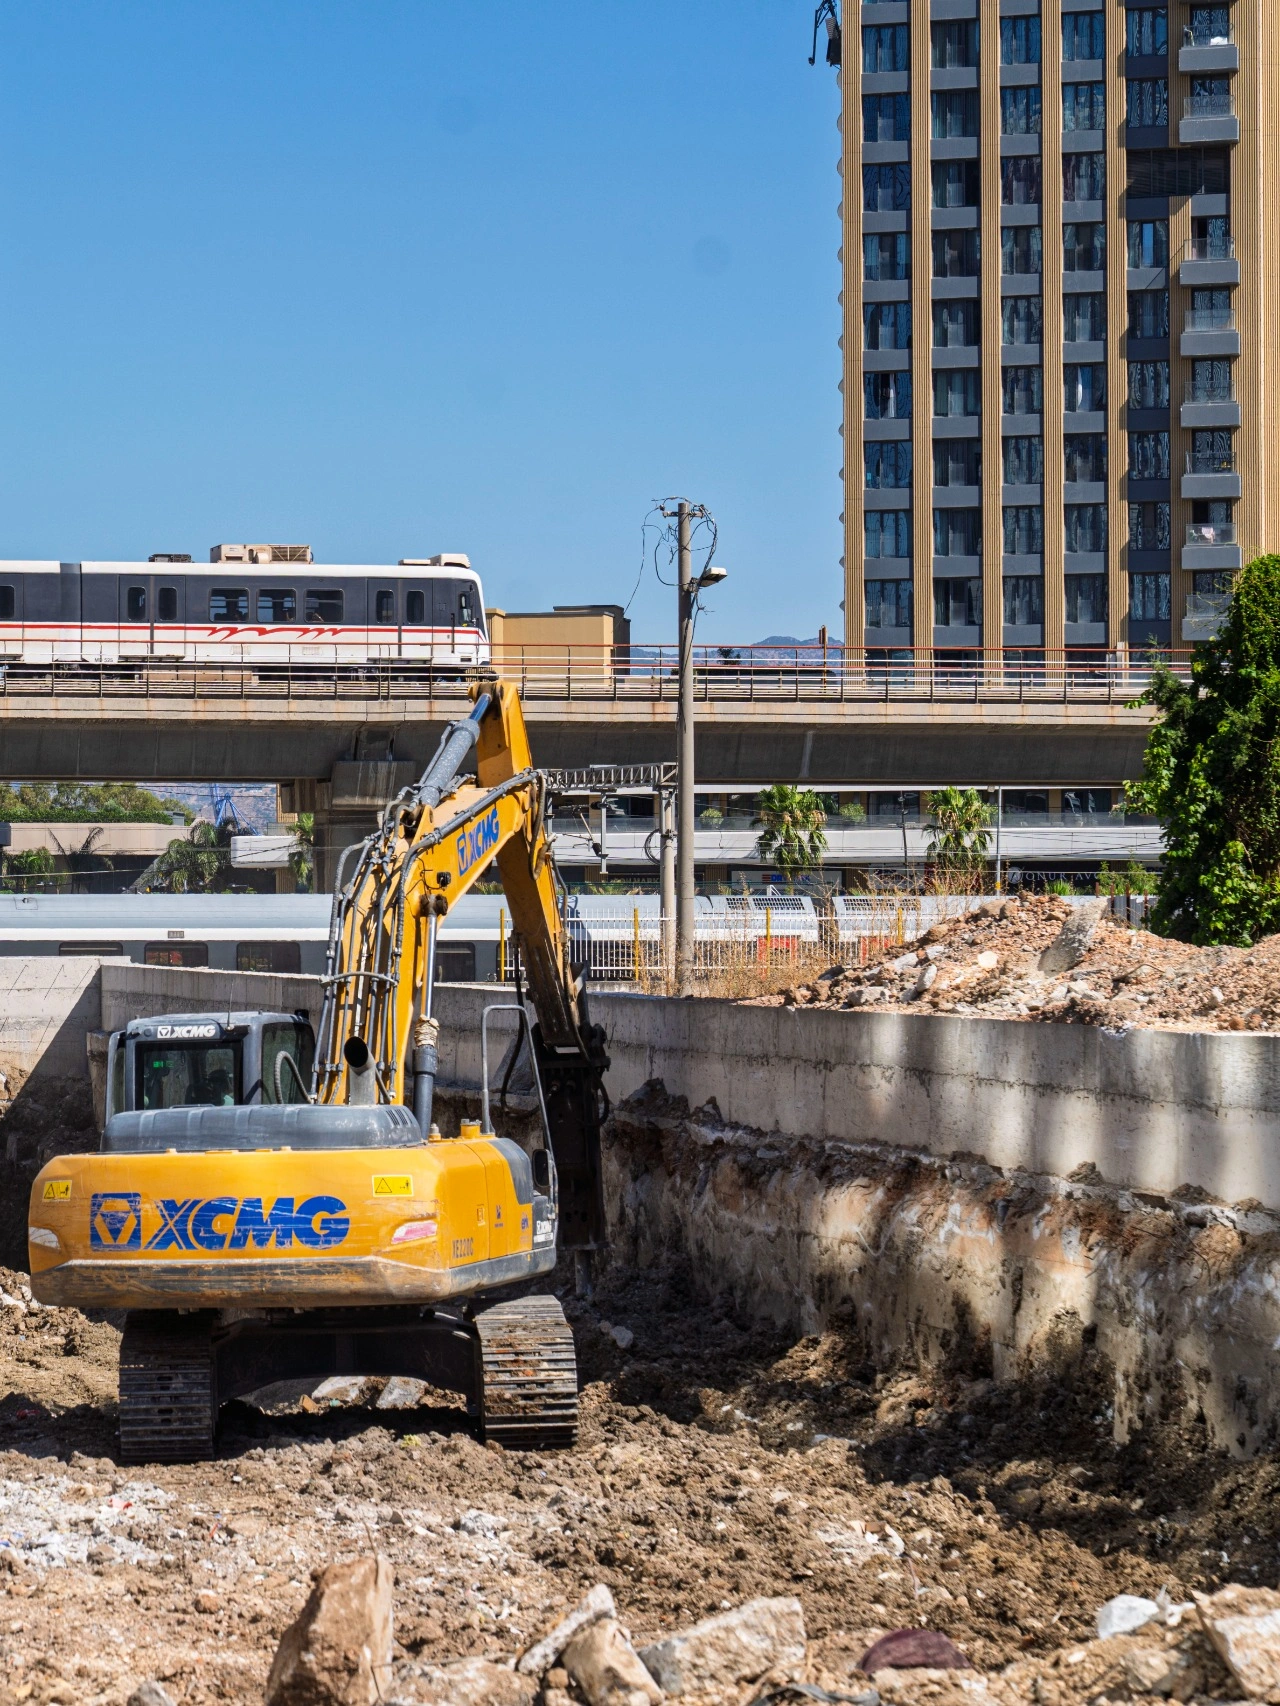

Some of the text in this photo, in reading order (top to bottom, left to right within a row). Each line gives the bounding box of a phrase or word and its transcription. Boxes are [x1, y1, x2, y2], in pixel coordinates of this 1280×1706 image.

[468, 808, 500, 867] XCMG
[1025, 872, 1067, 881] ONUR
[171, 1025, 216, 1038] XCMG
[143, 1195, 350, 1251] XCMG
